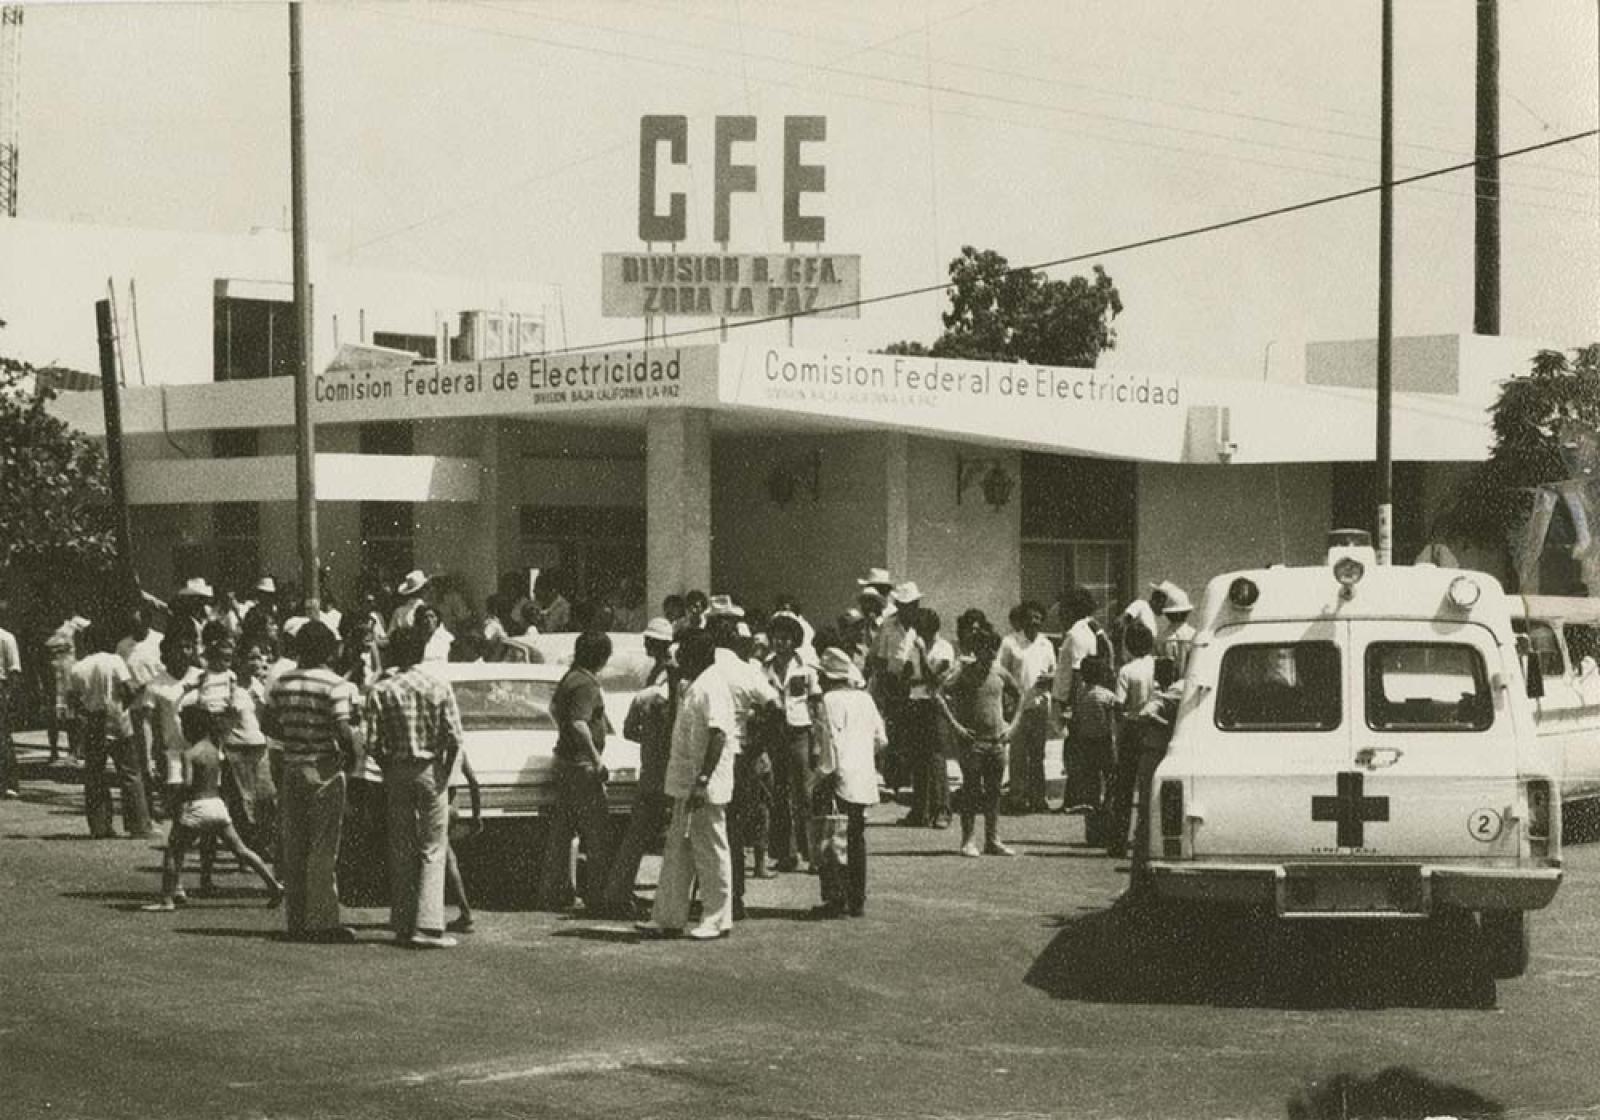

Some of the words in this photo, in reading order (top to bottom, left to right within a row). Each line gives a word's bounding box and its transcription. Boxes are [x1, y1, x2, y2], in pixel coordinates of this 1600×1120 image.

[638, 114, 827, 242] CFE
[622, 256, 740, 283] DIVISION
[643, 287, 712, 313] ZONA
[723, 287, 753, 314] LA
[768, 287, 819, 315] PAZ
[314, 372, 393, 403] Comision
[404, 362, 483, 397] Federal
[492, 361, 519, 391] de
[529, 349, 681, 389] Electricidad
[765, 349, 885, 388] Comision
[894, 359, 990, 394] Federal
[1000, 367, 1028, 396] de
[1036, 369, 1179, 406] Electricidad
[1478, 815, 1490, 833] 2
